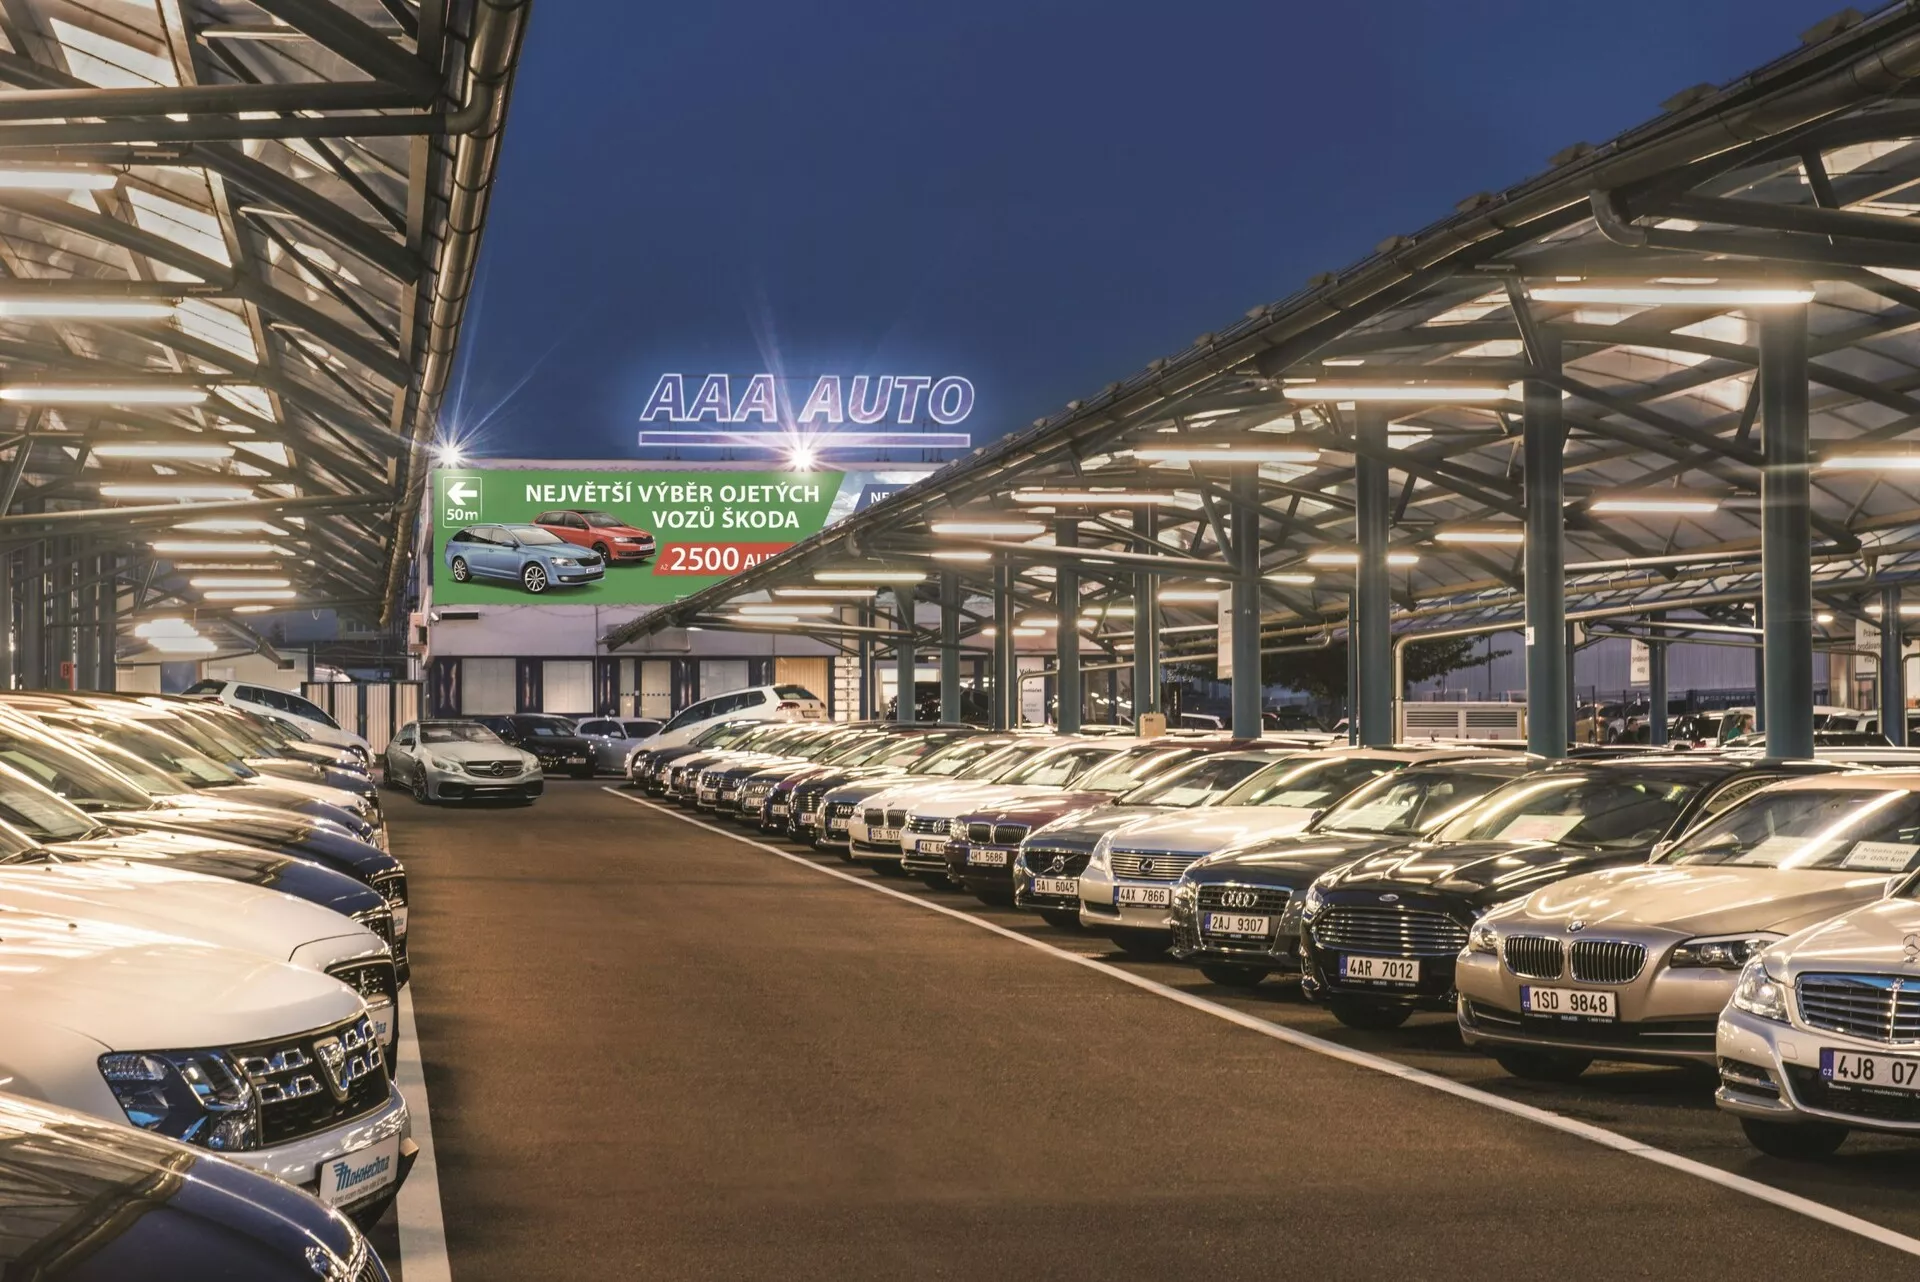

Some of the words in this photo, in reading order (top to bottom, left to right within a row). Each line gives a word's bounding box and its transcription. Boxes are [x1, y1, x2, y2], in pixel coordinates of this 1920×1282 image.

[640, 373, 777, 422] AAA
[797, 375, 975, 425] AUTO
[526, 481, 632, 503] NEJVĚTŠÍ
[638, 482, 713, 503] VÝBĚR
[719, 482, 820, 503] OJETÝCH
[446, 508, 479, 521] 50m
[651, 506, 715, 529] VOZŮ
[722, 507, 800, 529] ŠKODA
[659, 563, 668, 571] AŽ
[670, 547, 740, 571] 2500
[1055, 881, 1075, 893] 6045
[1120, 889, 1136, 902] 4AX
[1142, 890, 1165, 903] 7866
[1212, 916, 1231, 930] 2AJ
[1237, 918, 1264, 932] 9307
[1349, 959, 1373, 976] 4AR
[1382, 961, 1413, 979] 7012
[1533, 990, 1559, 1010] 1SD
[1570, 993, 1608, 1013] 9848
[1822, 1068, 1833, 1076] CZ
[1837, 1055, 1875, 1081] 4J8
[1891, 1061, 1919, 1086] 07
